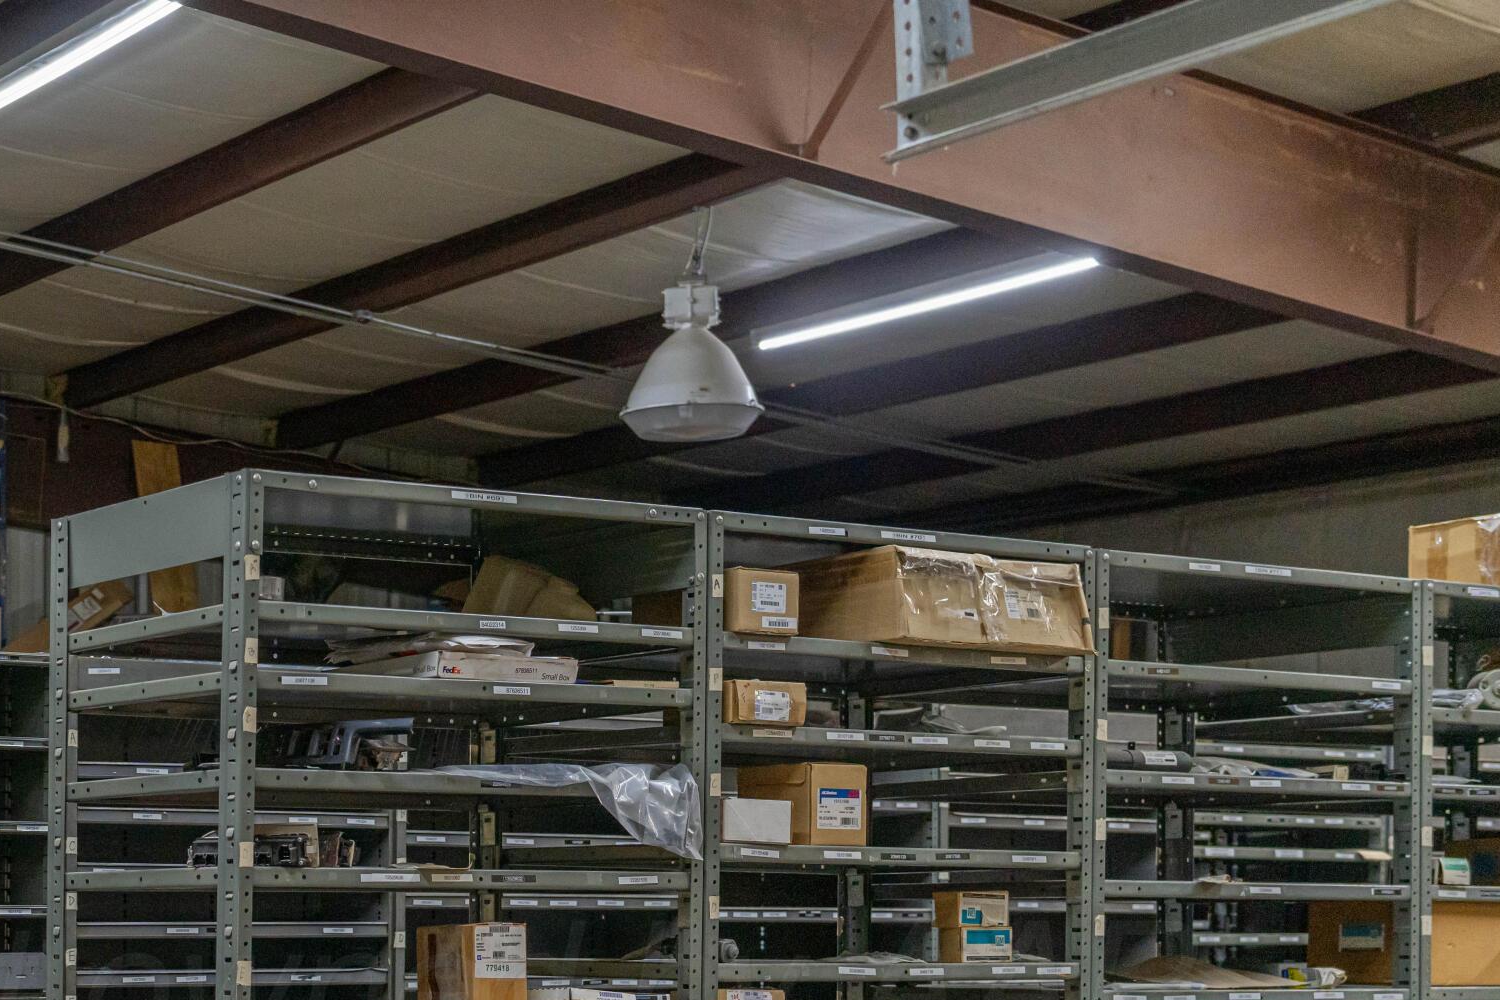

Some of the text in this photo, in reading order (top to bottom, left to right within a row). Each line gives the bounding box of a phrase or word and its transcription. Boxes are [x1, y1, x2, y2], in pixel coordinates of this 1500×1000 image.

[713, 578, 721, 590] A
[442, 665, 461, 674] FedEx
[69, 732, 76, 745] A
[68, 895, 75, 906] D
[68, 950, 75, 962] E
[485, 964, 510, 972] 779418
